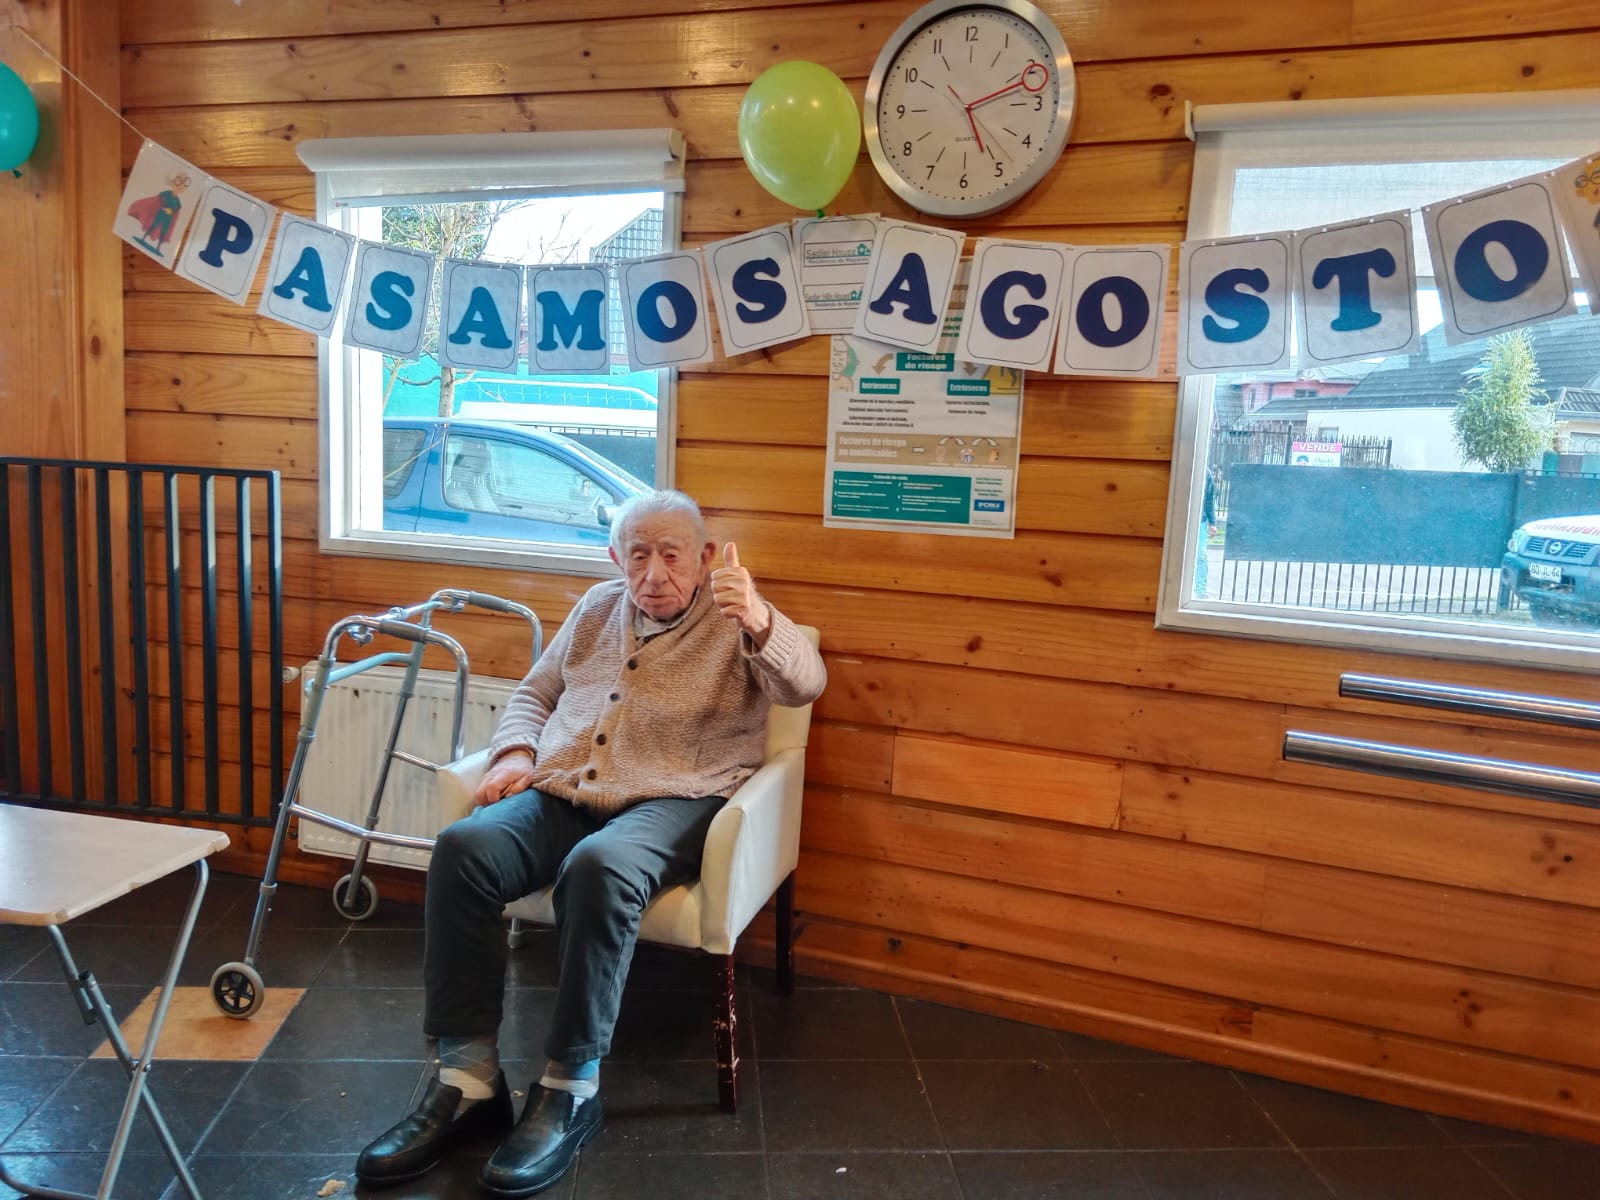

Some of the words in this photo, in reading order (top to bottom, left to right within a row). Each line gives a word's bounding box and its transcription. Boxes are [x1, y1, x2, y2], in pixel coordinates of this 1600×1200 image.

[965, 26, 979, 42] 12
[933, 38, 942, 54] 11
[1026, 59, 1037, 74] 2
[904, 67, 918, 83] 10
[1033, 95, 1043, 111] 3
[896, 104, 905, 120] 9
[903, 141, 912, 157] 8
[1022, 134, 1032, 149] 4
[926, 165, 935, 180] 7
[994, 162, 1004, 178] 5
[959, 174, 969, 189] 6
[198, 207, 787, 351] PASAMOS
[870, 219, 1550, 348] AGOSTO
[905, 362, 917, 370] de
[918, 362, 947, 370] riesgo
[1299, 443, 1337, 452] VENDE
